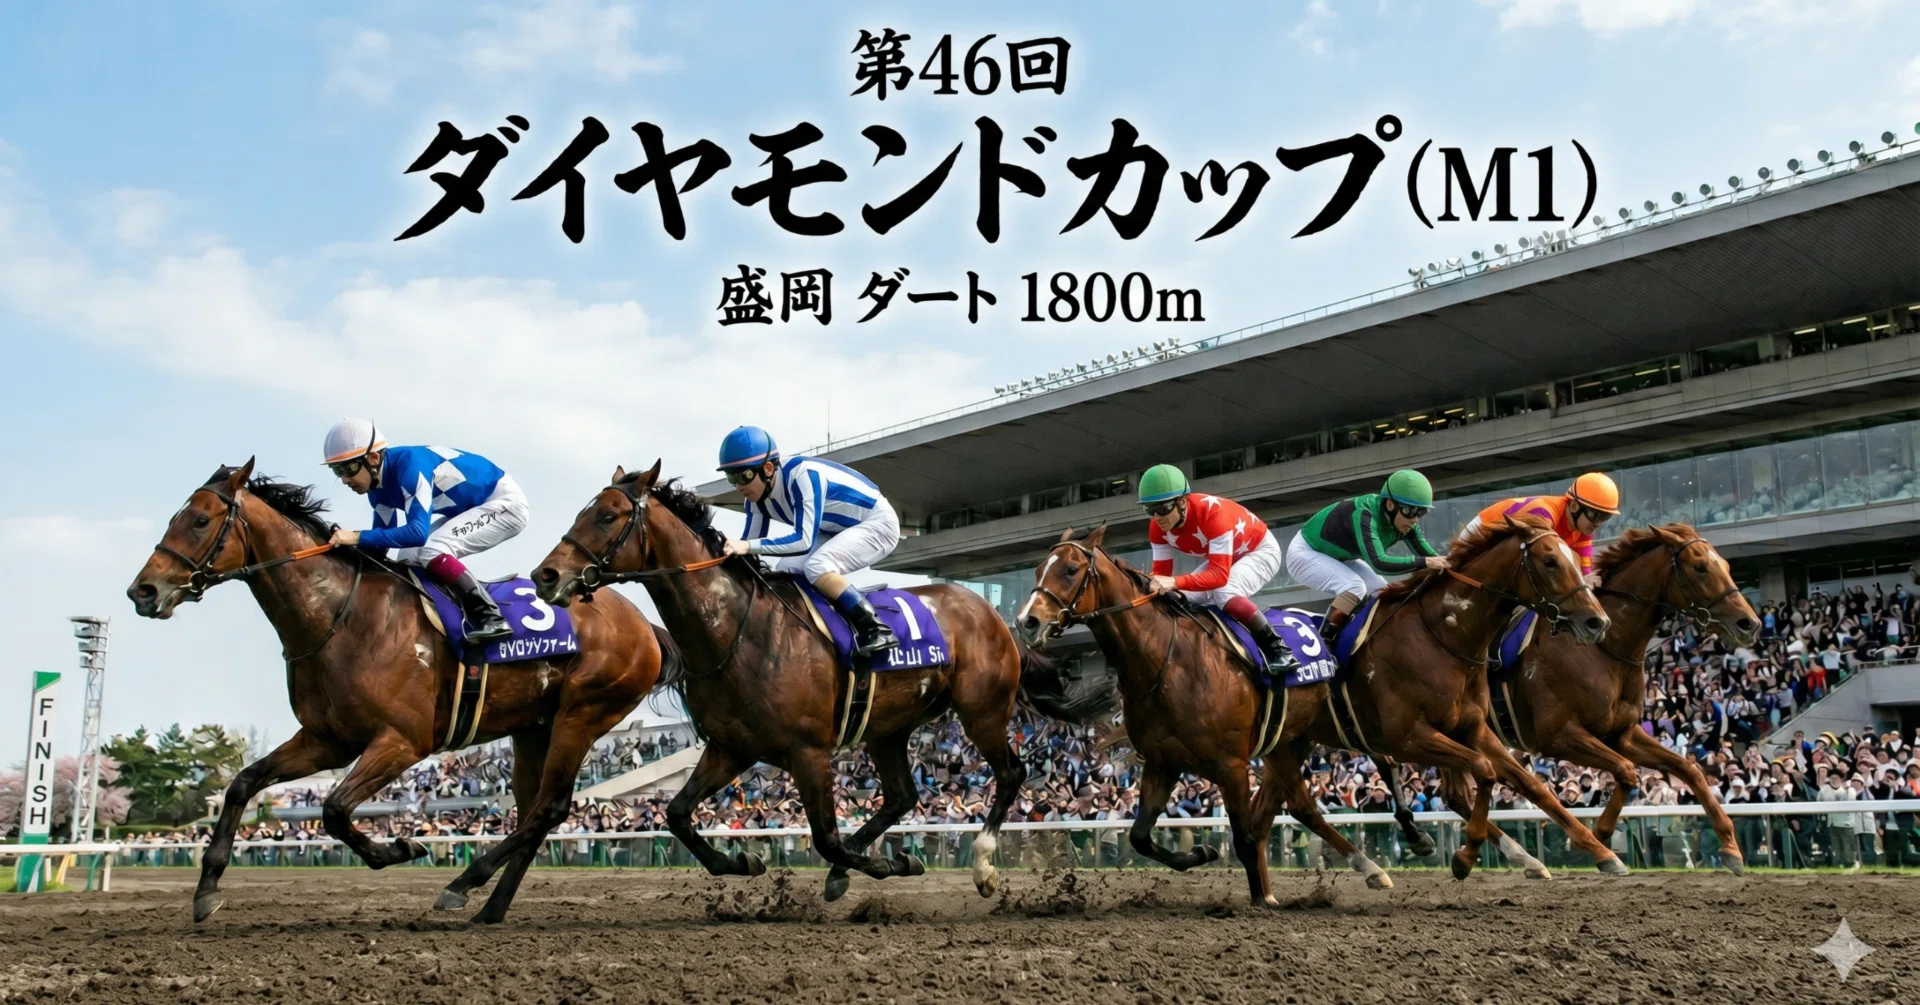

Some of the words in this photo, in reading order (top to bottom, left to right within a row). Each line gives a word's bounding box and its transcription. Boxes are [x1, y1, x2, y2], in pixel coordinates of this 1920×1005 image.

[513, 587, 556, 632] 3
[892, 596, 923, 641] 1
[1282, 616, 1322, 658] 3
[30, 698, 54, 825] FINISH
